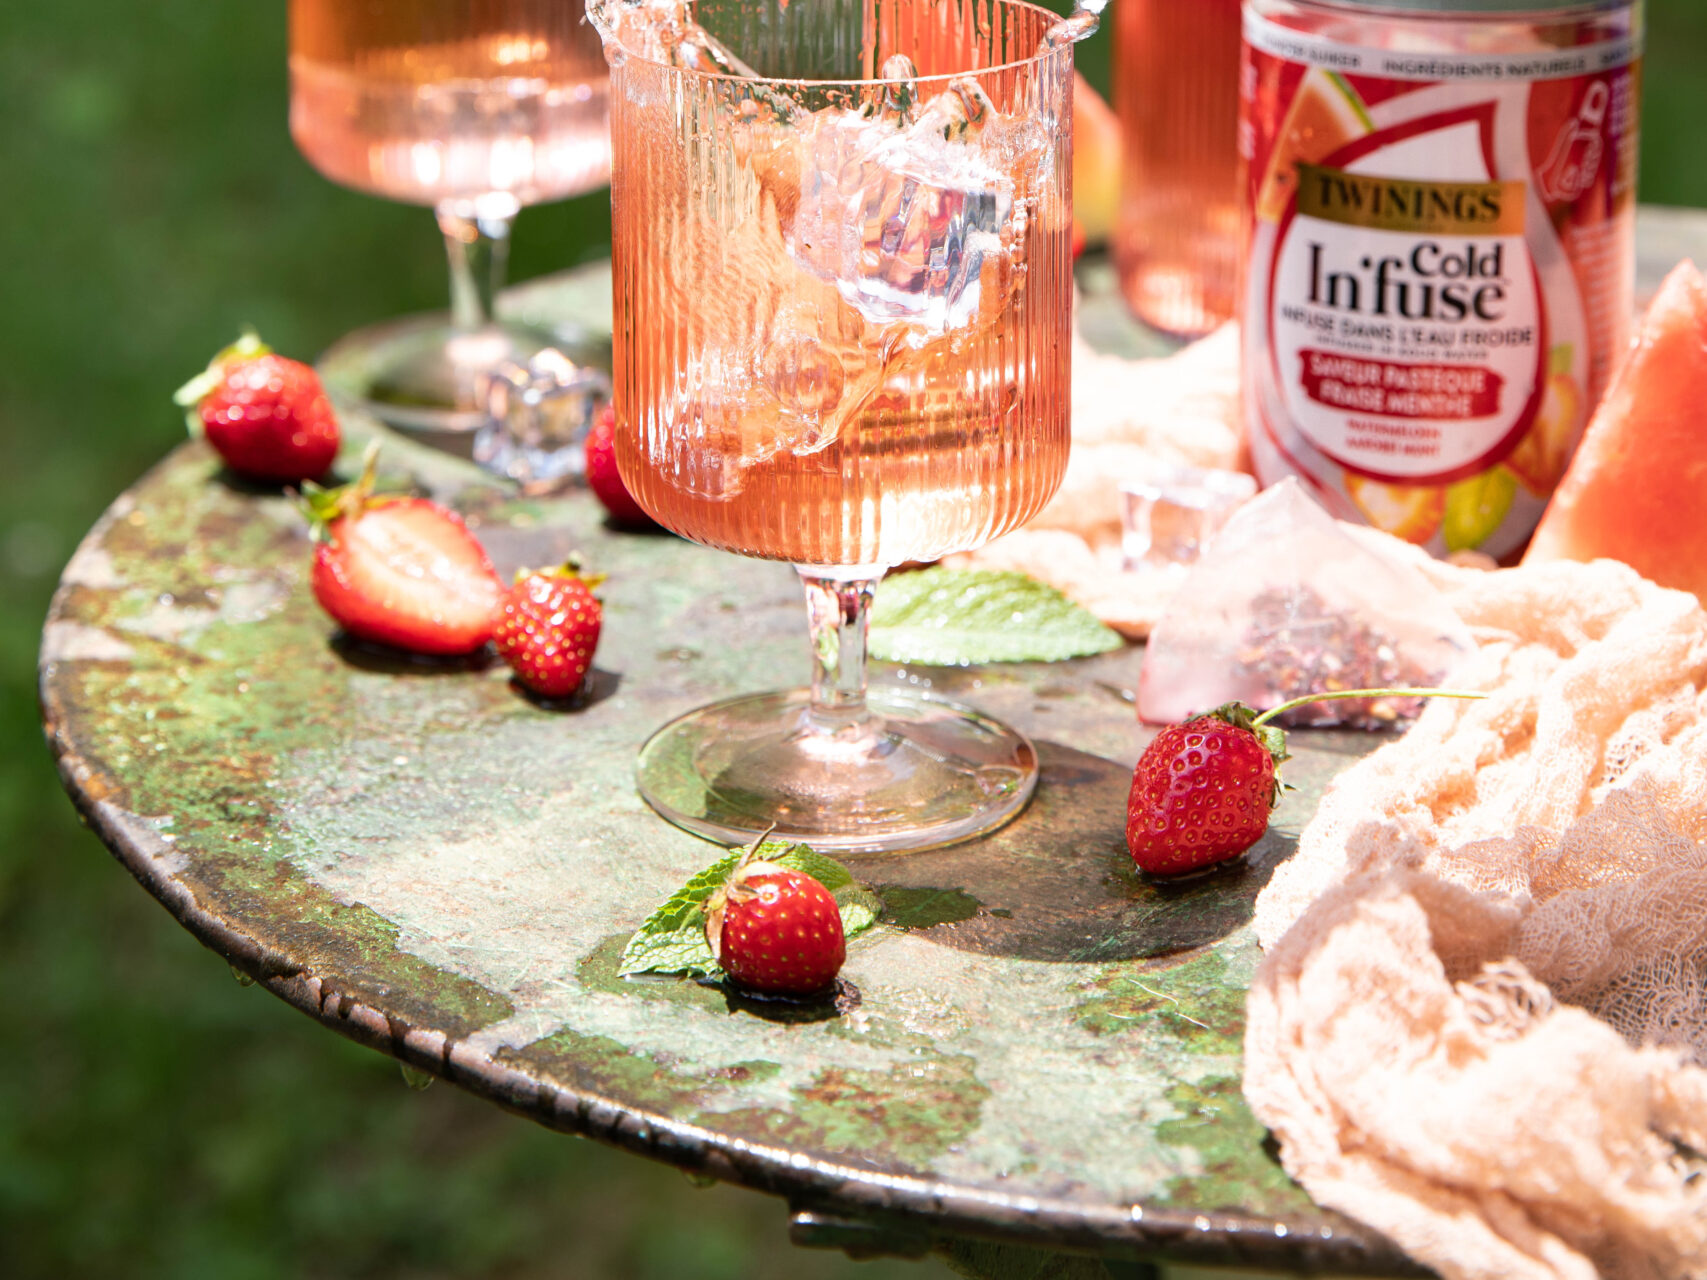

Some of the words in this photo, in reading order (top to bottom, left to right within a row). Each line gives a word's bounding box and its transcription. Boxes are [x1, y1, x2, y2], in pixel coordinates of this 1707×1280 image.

[1318, 174, 1501, 222] TWININGS
[1410, 241, 1504, 278] Cold
[1282, 304, 1335, 331] INFUSE
[1341, 318, 1392, 341] DANS
[1399, 324, 1456, 345] L'EAU
[1460, 325, 1533, 346] FROIDE
[1310, 353, 1382, 384] SAVEUR
[1319, 379, 1386, 411] FRAISE
[1388, 391, 1473, 417] MENTHE
